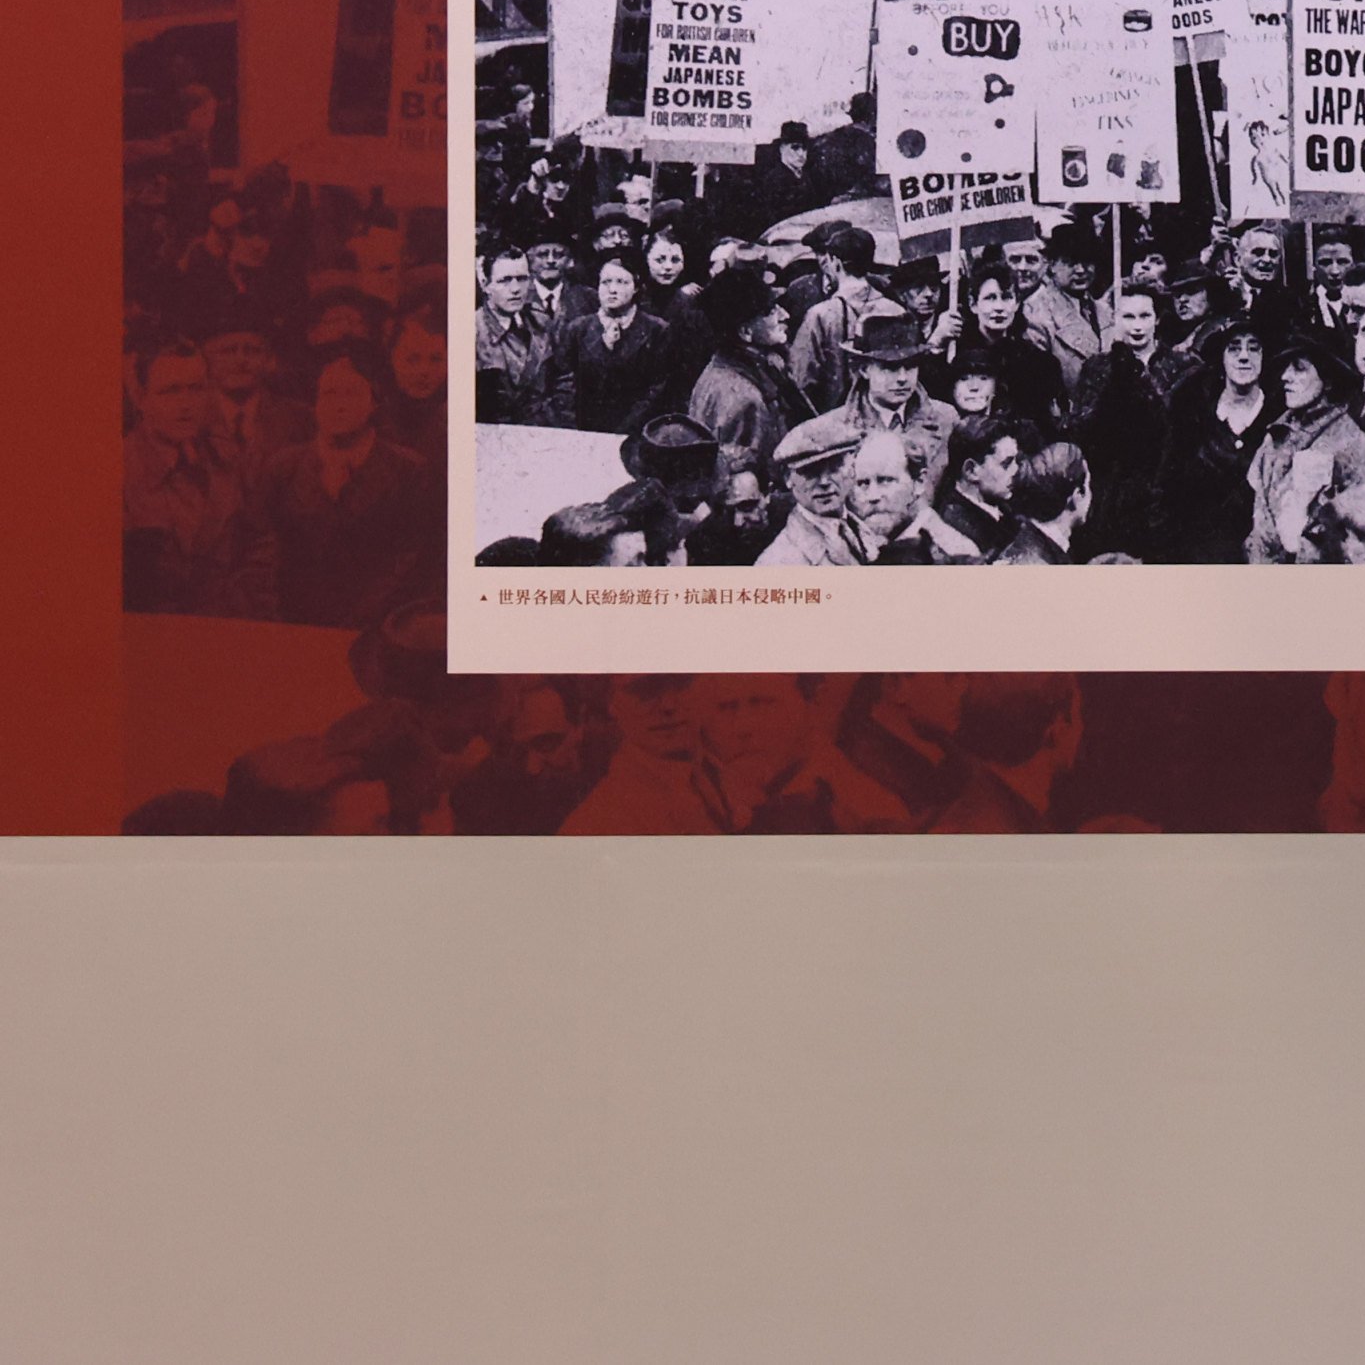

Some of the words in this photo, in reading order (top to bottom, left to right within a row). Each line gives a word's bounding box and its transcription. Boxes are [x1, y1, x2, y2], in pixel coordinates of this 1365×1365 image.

[671, 1, 743, 24] TOYS
[1305, 7, 1332, 35] THE
[656, 23, 673, 39] FOR
[676, 25, 712, 41] BRITISH
[714, 27, 756, 44] CHILDREN
[950, 22, 1015, 53] BUY
[668, 43, 741, 65] MEAN
[663, 67, 745, 87] JAPANESE
[652, 87, 752, 110] BOMBS
[651, 110, 669, 128] FOR
[671, 112, 707, 128] CHINESE
[709, 112, 752, 129] CHILDREN
[903, 201, 925, 223] FOR
[972, 185, 1026, 209] CHILDREN
[498, 587, 834, 606] 世界各國人民紛紛遊行,抗議日本侵略中國。
